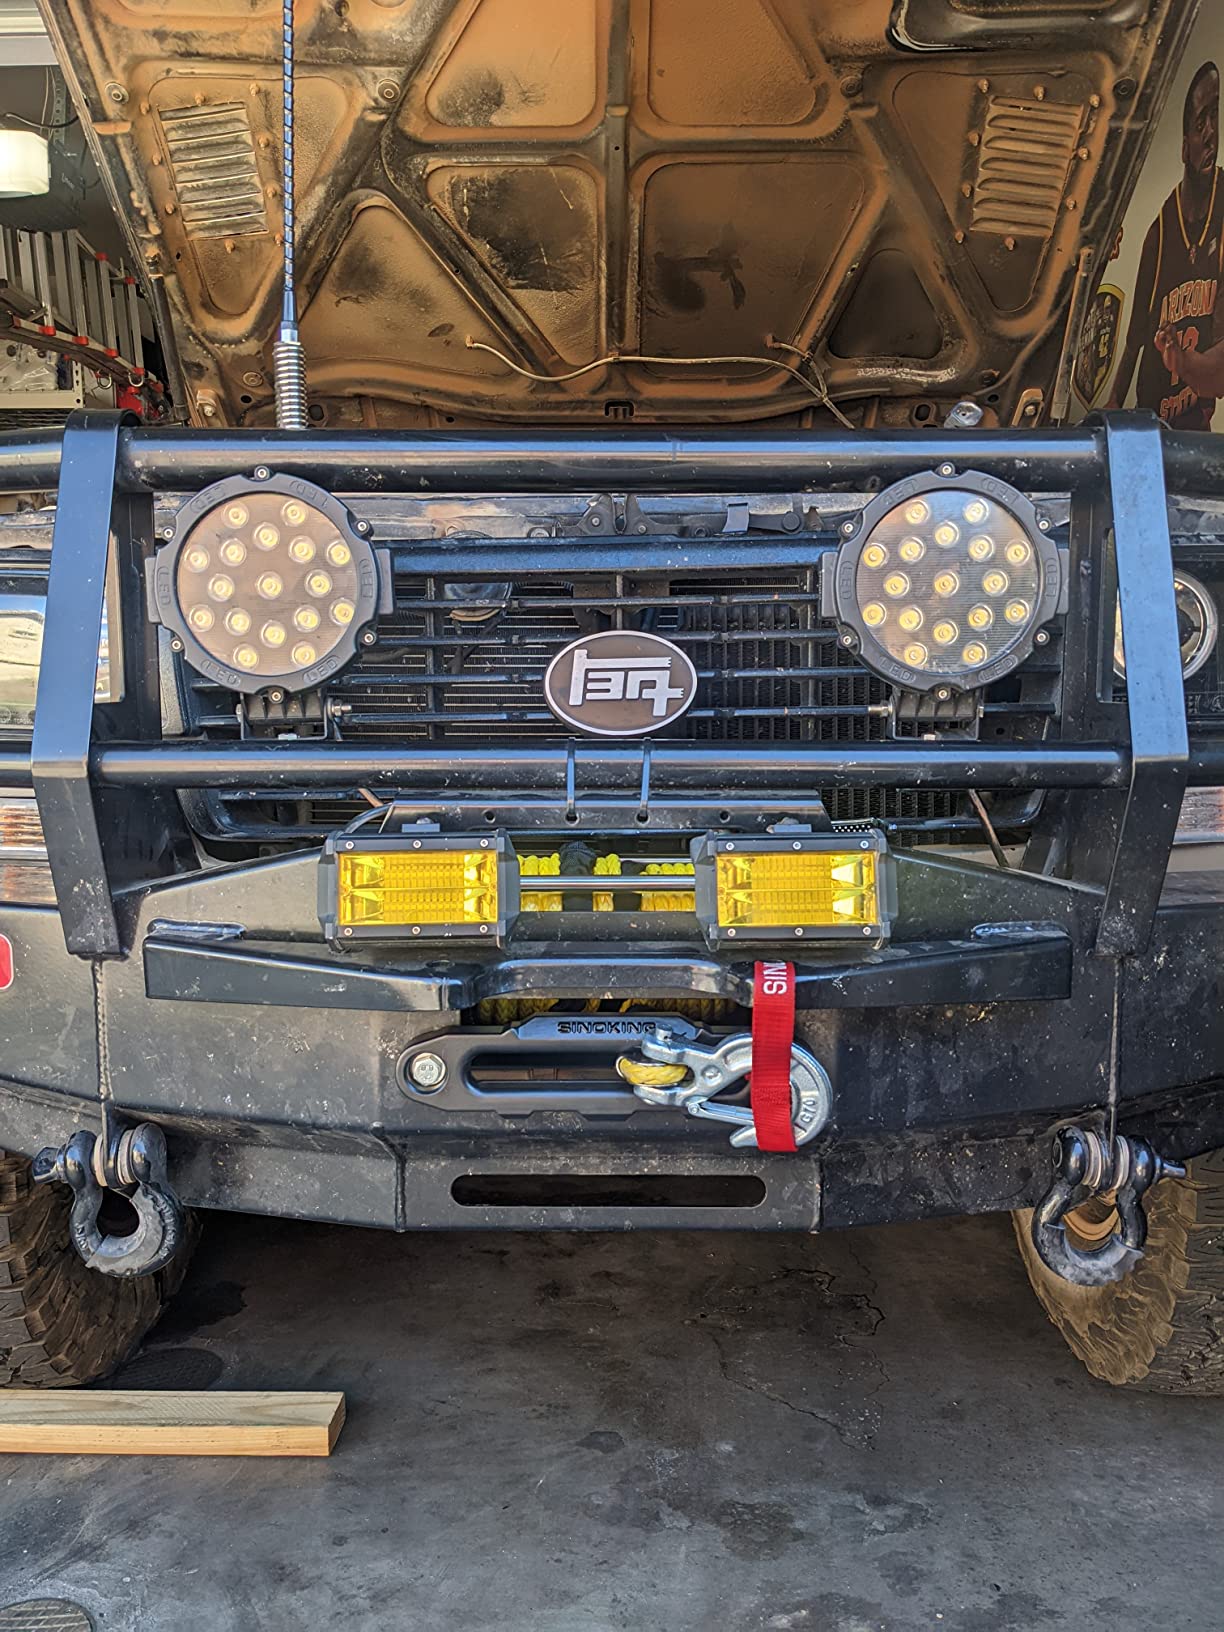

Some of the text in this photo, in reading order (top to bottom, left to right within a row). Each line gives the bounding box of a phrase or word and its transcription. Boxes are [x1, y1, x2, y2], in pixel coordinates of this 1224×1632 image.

[1159, 279, 1217, 328] ARIZON
[159, 569, 172, 606] LED
[841, 565, 853, 600] LED
[1045, 563, 1058, 598] LED
[307, 658, 338, 682] LED
[881, 659, 914, 682] LED
[982, 658, 1014, 680] LED
[763, 961, 788, 995] SIN
[800, 1097, 817, 1123] G70
